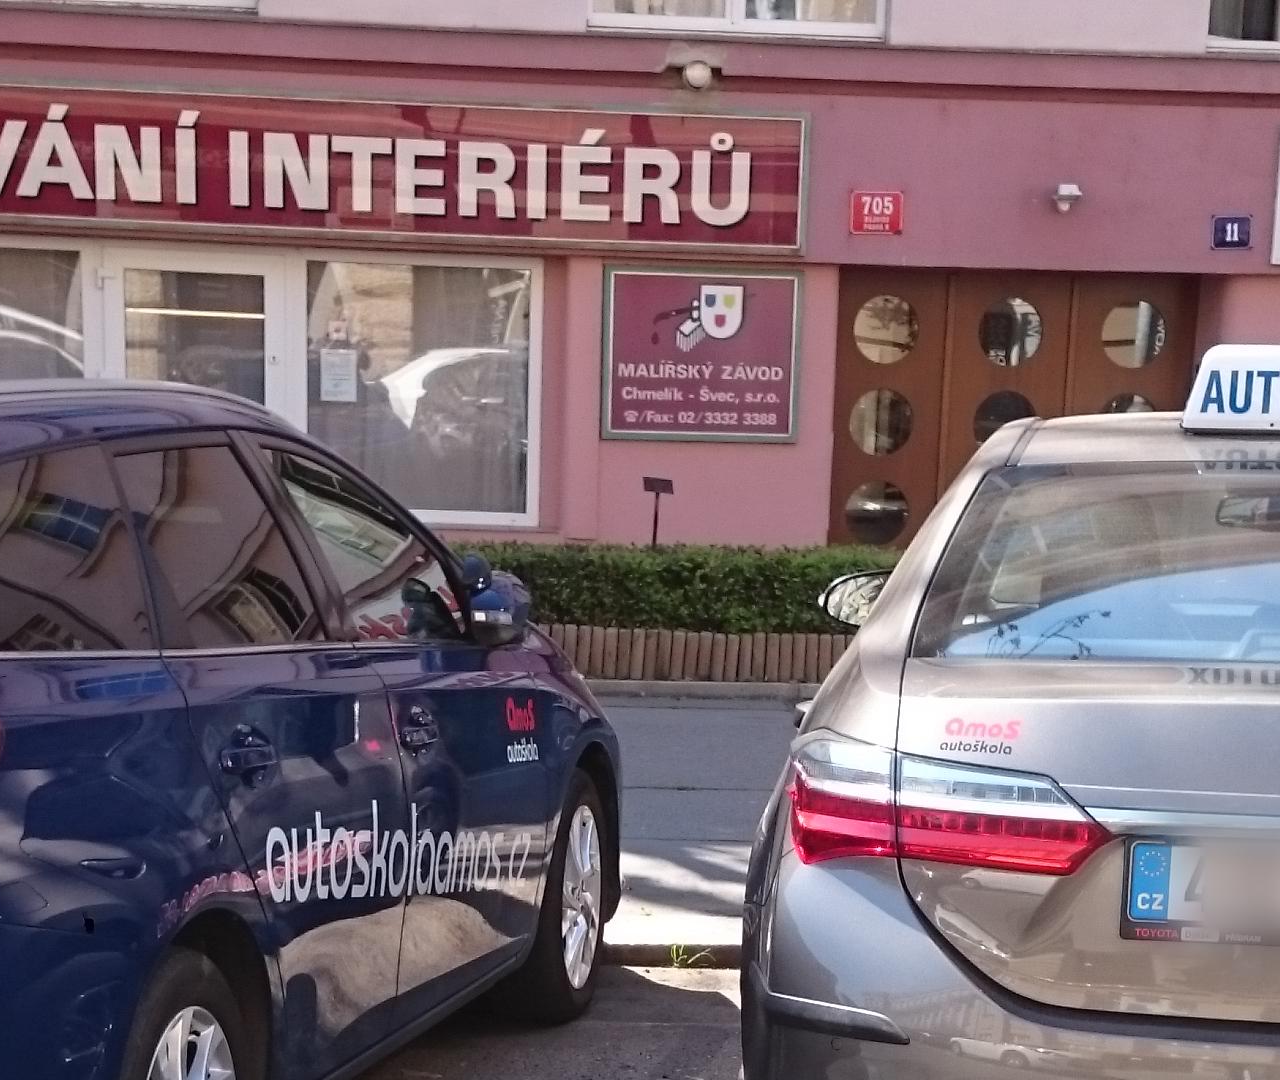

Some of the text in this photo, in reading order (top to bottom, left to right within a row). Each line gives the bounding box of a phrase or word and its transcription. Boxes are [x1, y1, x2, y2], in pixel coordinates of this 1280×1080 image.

[228, 128, 752, 227] INTERIÉRŮ
[861, 196, 893, 215] 705
[1226, 222, 1239, 242] 11
[618, 360, 784, 381] MALÍŘSKÝ ZÁVOD
[622, 386, 683, 401] Chmelík
[699, 385, 739, 404] Švec,
[745, 391, 780, 403] s.r.o.
[940, 740, 1012, 755] autoškola
[265, 799, 531, 903] autoskolaamos.cz
[1136, 893, 1164, 911] CZ
[1135, 927, 1179, 938] TOYOTA
